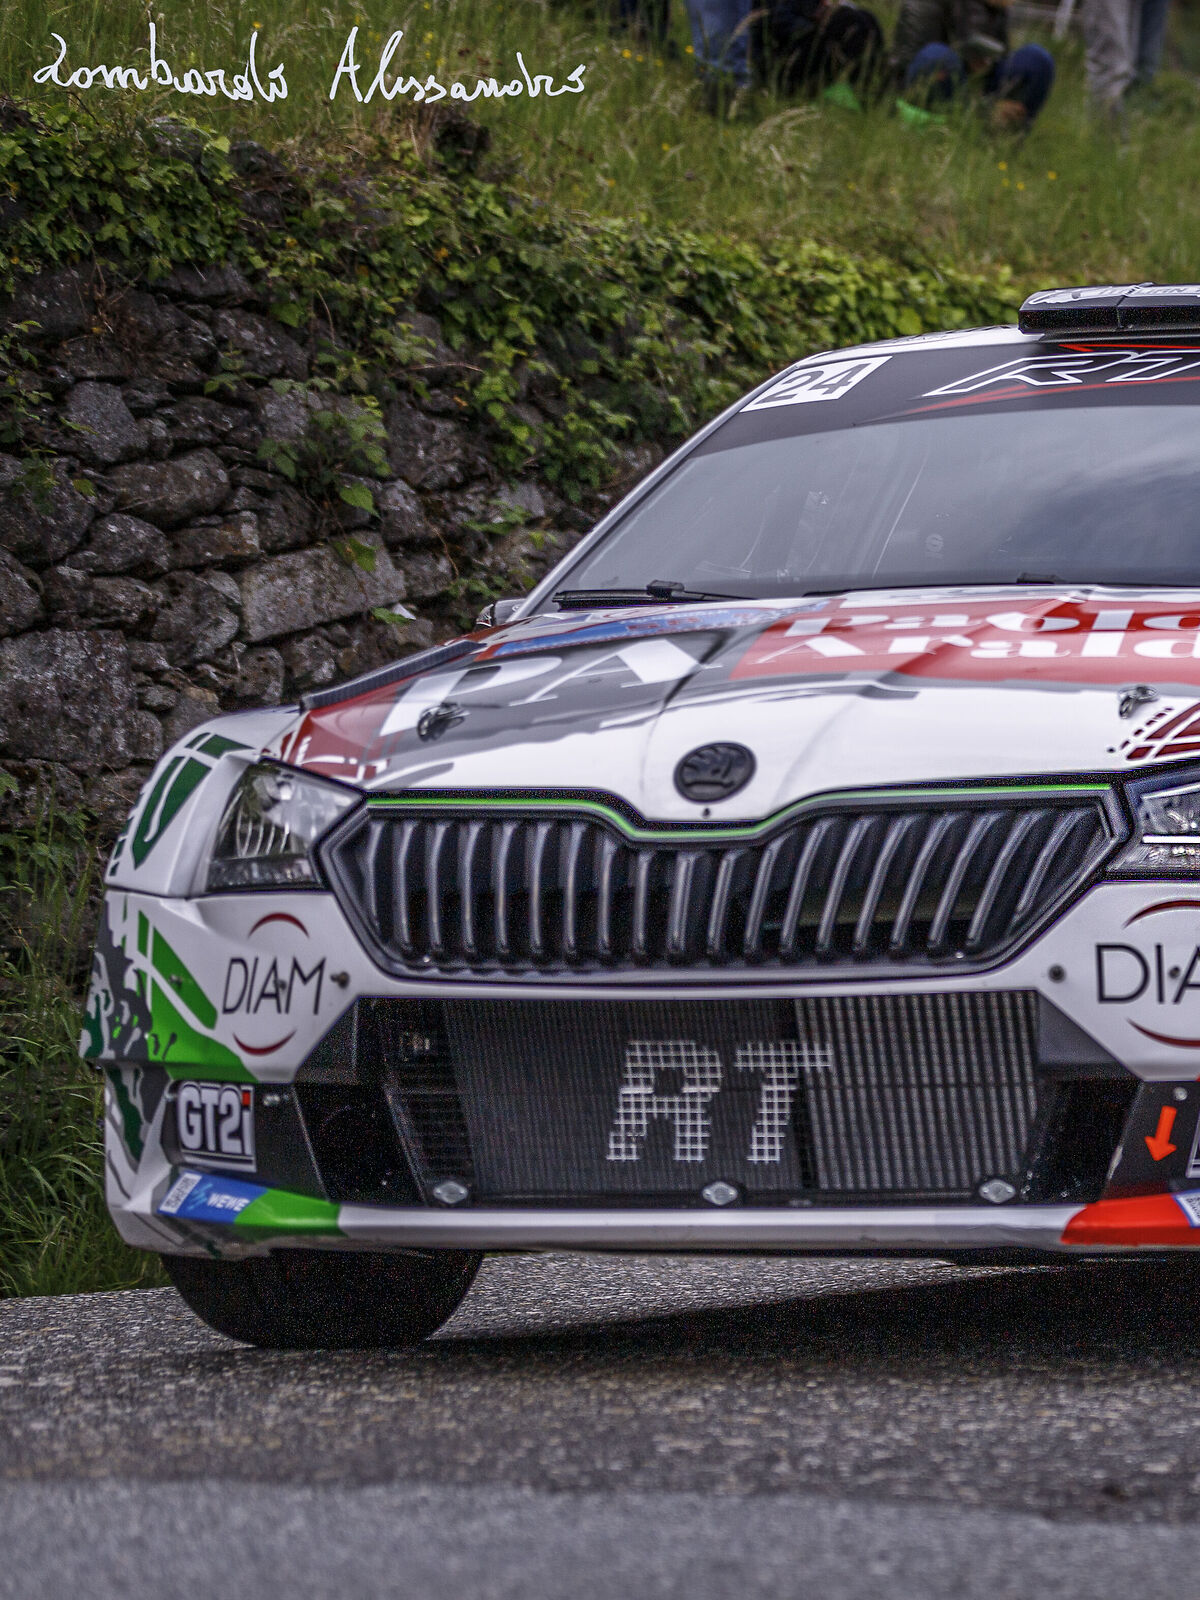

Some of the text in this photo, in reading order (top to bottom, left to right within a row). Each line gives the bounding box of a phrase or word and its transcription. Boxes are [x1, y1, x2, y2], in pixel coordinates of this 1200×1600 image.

[755, 362, 873, 405] 24
[221, 956, 328, 1015] DIAM
[177, 1084, 253, 1157] GT2i
[605, 1038, 834, 1163] RT
[207, 1192, 251, 1213] WEWE
